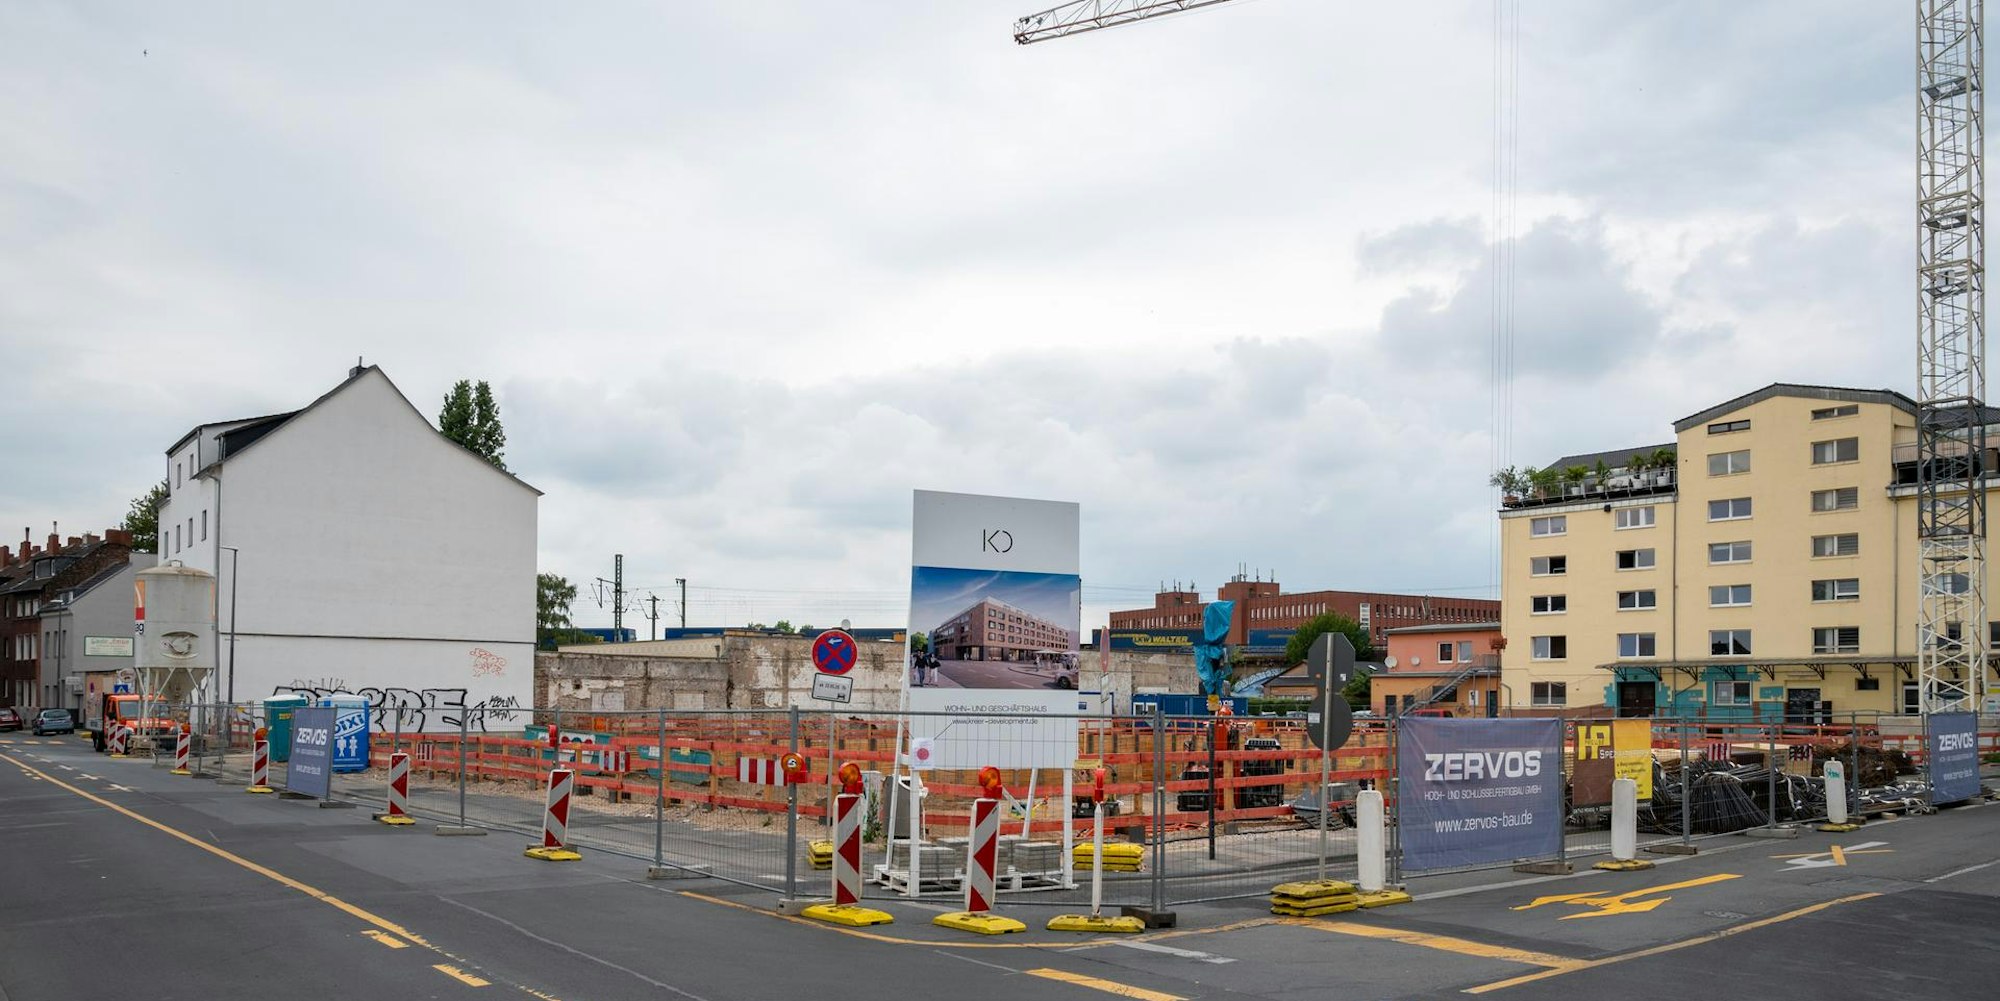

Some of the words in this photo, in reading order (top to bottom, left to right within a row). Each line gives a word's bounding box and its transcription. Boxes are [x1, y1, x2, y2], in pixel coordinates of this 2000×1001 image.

[944, 705, 971, 713] WOHN-
[988, 704, 1047, 713] GESCHÄFTSHAUS
[296, 727, 328, 746] ZERVOS
[1938, 732, 1974, 751] ZERVOS
[1424, 750, 1542, 781] ZERVOS
[1424, 790, 1445, 801] HOCH-
[1447, 789, 1460, 800] UND
[1461, 786, 1525, 799] SCHLÜSSELFERTIGBAU
[1434, 809, 1533, 833] www.zervos-bau.de
